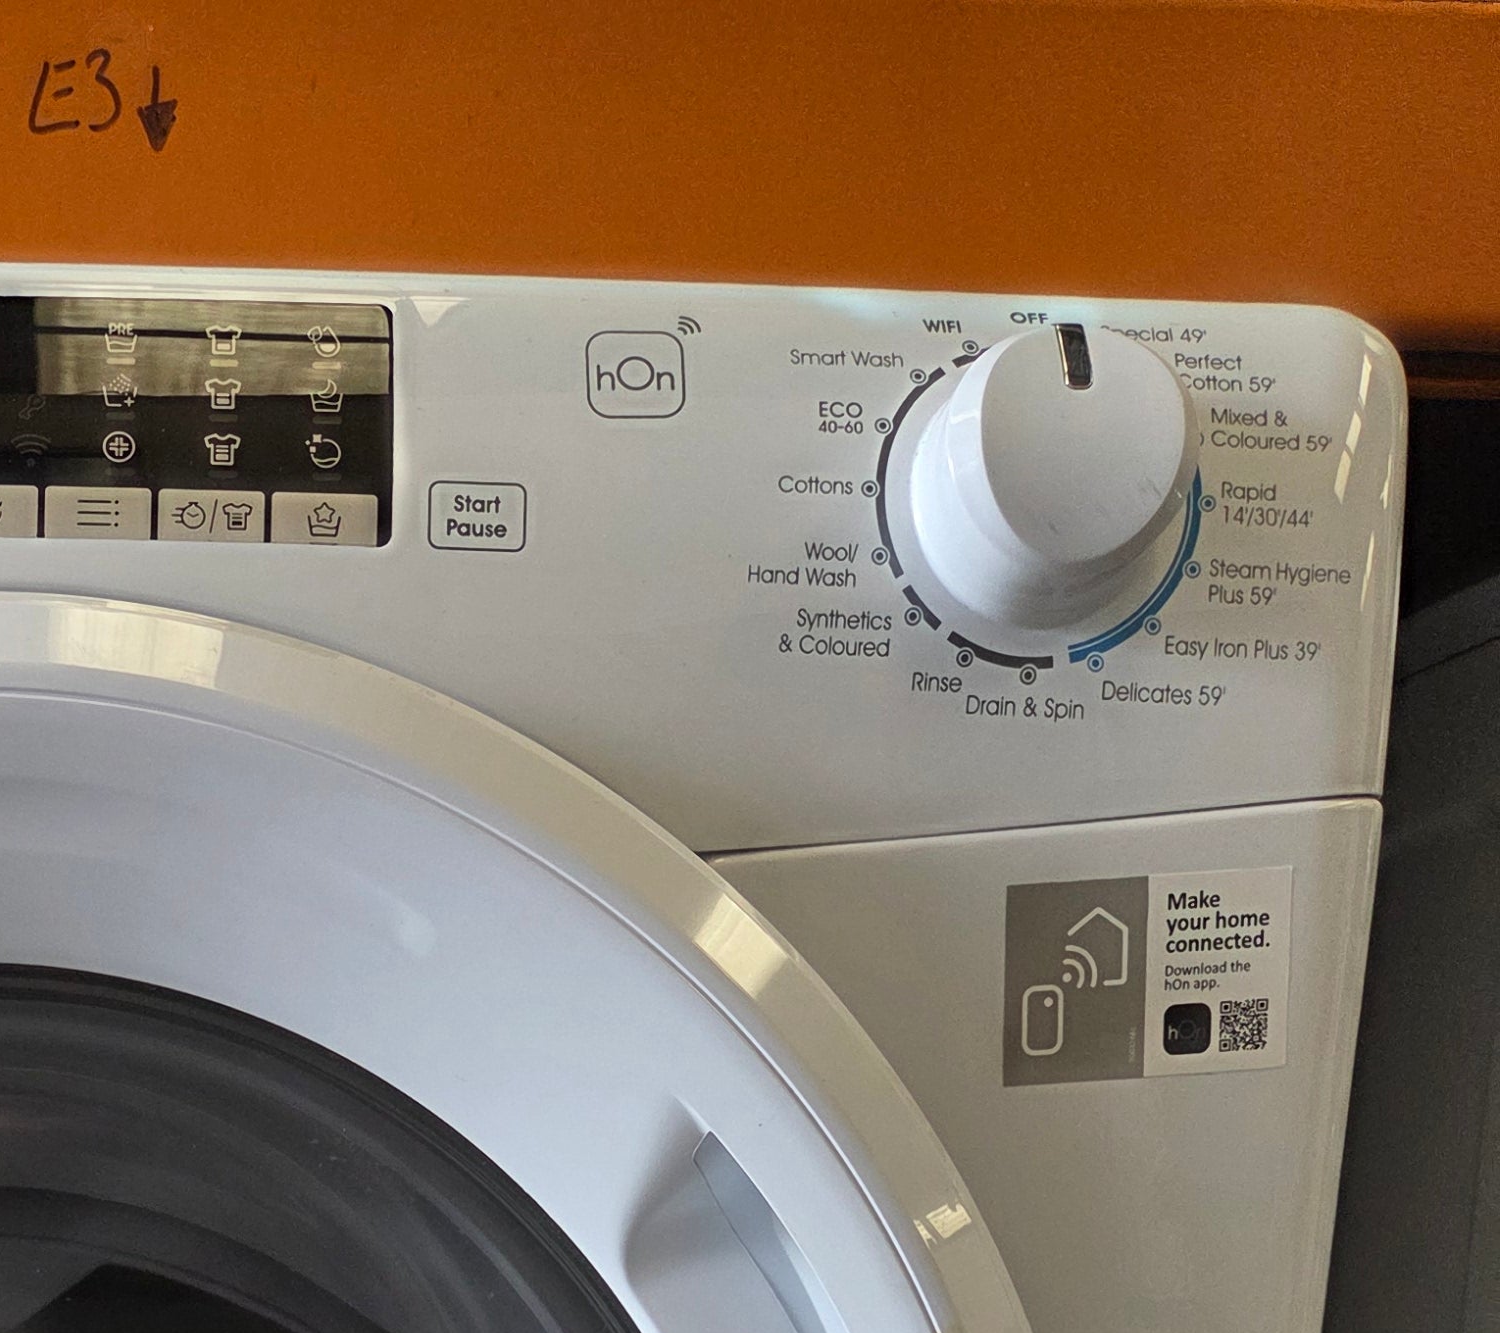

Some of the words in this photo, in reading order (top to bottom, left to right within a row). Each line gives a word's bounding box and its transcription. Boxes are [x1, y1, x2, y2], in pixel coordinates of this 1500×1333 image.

[28, 48, 122, 135] E3
[923, 319, 962, 334] WIFI
[1010, 312, 1049, 325] OFF
[108, 323, 135, 336] PRE
[1101, 325, 1173, 342] ecial
[790, 349, 846, 367] Smart
[850, 351, 904, 369] Wash
[1174, 353, 1242, 371] Perfect
[596, 356, 675, 391] hOn
[819, 401, 863, 418] ECO
[1210, 408, 1268, 427] Mixed
[1274, 411, 1288, 427] &
[818, 420, 864, 435] 40-60
[1210, 430, 1300, 452] Coloured
[778, 475, 853, 496] Cottons
[1221, 481, 1277, 504] Rapid
[453, 493, 501, 514] Start
[446, 517, 507, 540] Pause
[804, 542, 858, 563] Wool/
[748, 564, 800, 585] Hand
[804, 566, 857, 588] Wash
[1209, 558, 1271, 580] Steam
[1276, 562, 1351, 587] Hygiene
[1208, 584, 1244, 605] Plus
[796, 608, 892, 631] Synthetics
[779, 634, 793, 654] &
[798, 634, 891, 657] Coloured
[1164, 635, 1208, 659] Easy
[1214, 636, 1248, 659] Iron
[1254, 639, 1289, 661] Plus
[911, 672, 963, 693] Rinse
[1101, 681, 1192, 705] Delicates
[965, 695, 1016, 718] Drain
[1023, 698, 1038, 718] &
[1044, 698, 1085, 723] Spin
[1167, 890, 1221, 911] Make
[1166, 916, 1210, 936] your
[1215, 911, 1270, 929] home
[1165, 931, 1271, 953] connected.
[1164, 961, 1228, 977] Download
[1231, 961, 1251, 973] the
[1164, 978, 1190, 991] hOn
[1193, 979, 1220, 992] app.
